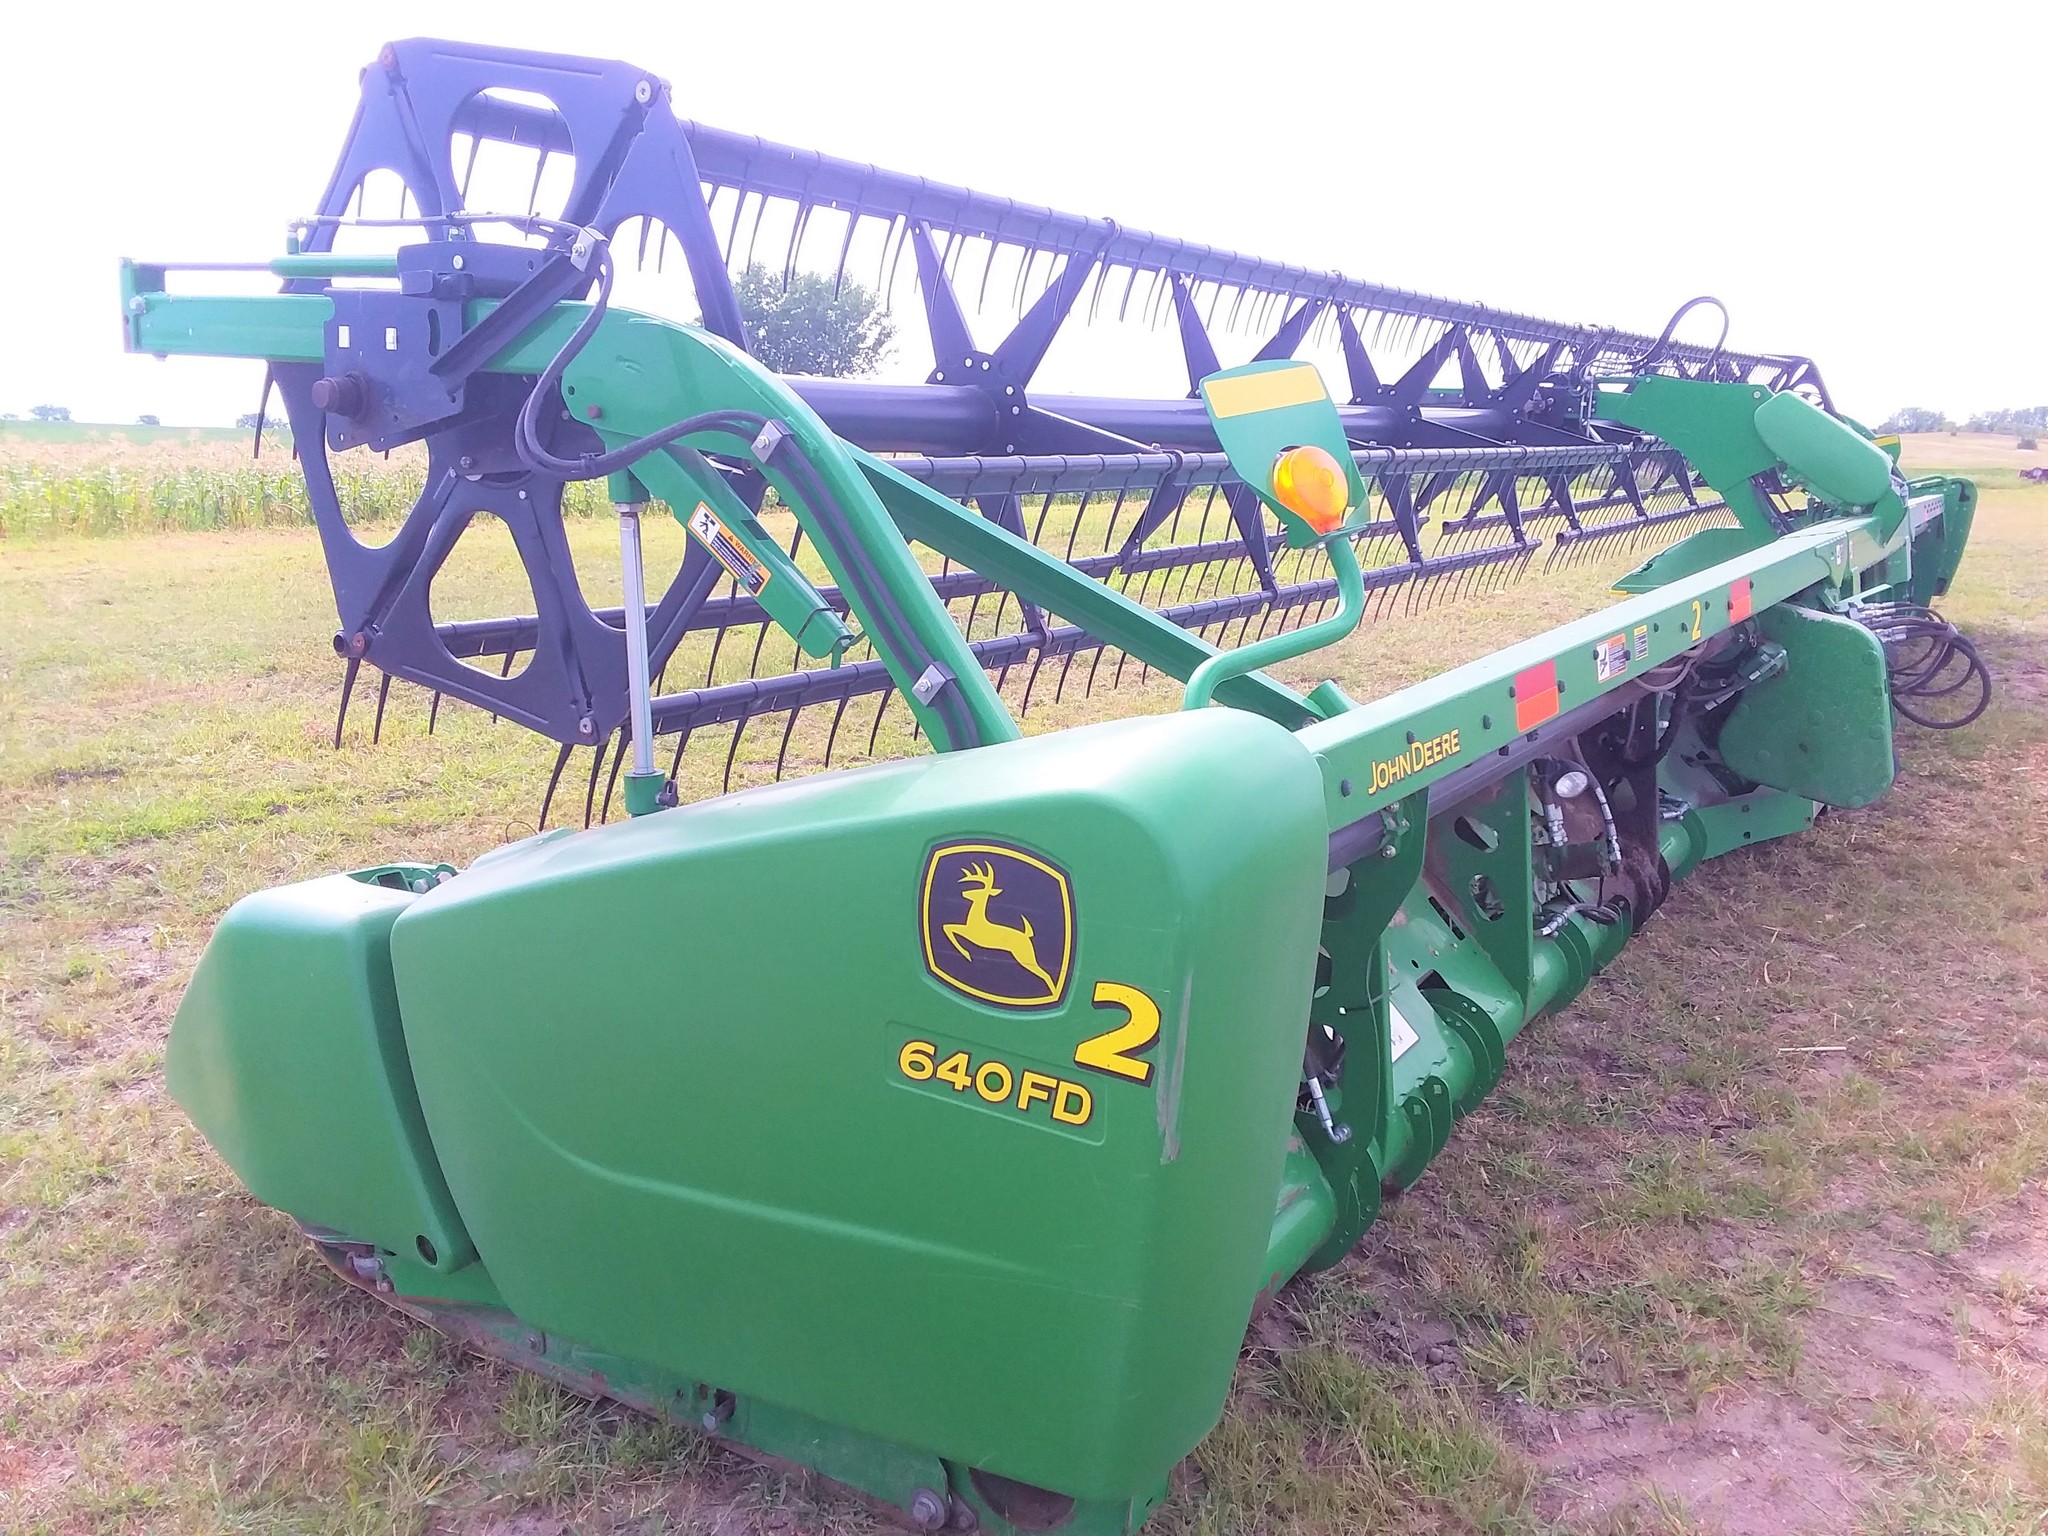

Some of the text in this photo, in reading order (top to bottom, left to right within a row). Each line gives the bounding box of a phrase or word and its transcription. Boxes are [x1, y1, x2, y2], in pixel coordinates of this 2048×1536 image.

[734, 540, 761, 568] WARNI
[1691, 599, 1702, 641] 2
[1367, 728, 1461, 795] JOHN DEERE
[1074, 981, 1162, 1087] 2
[897, 1039, 1094, 1127] 640FD
